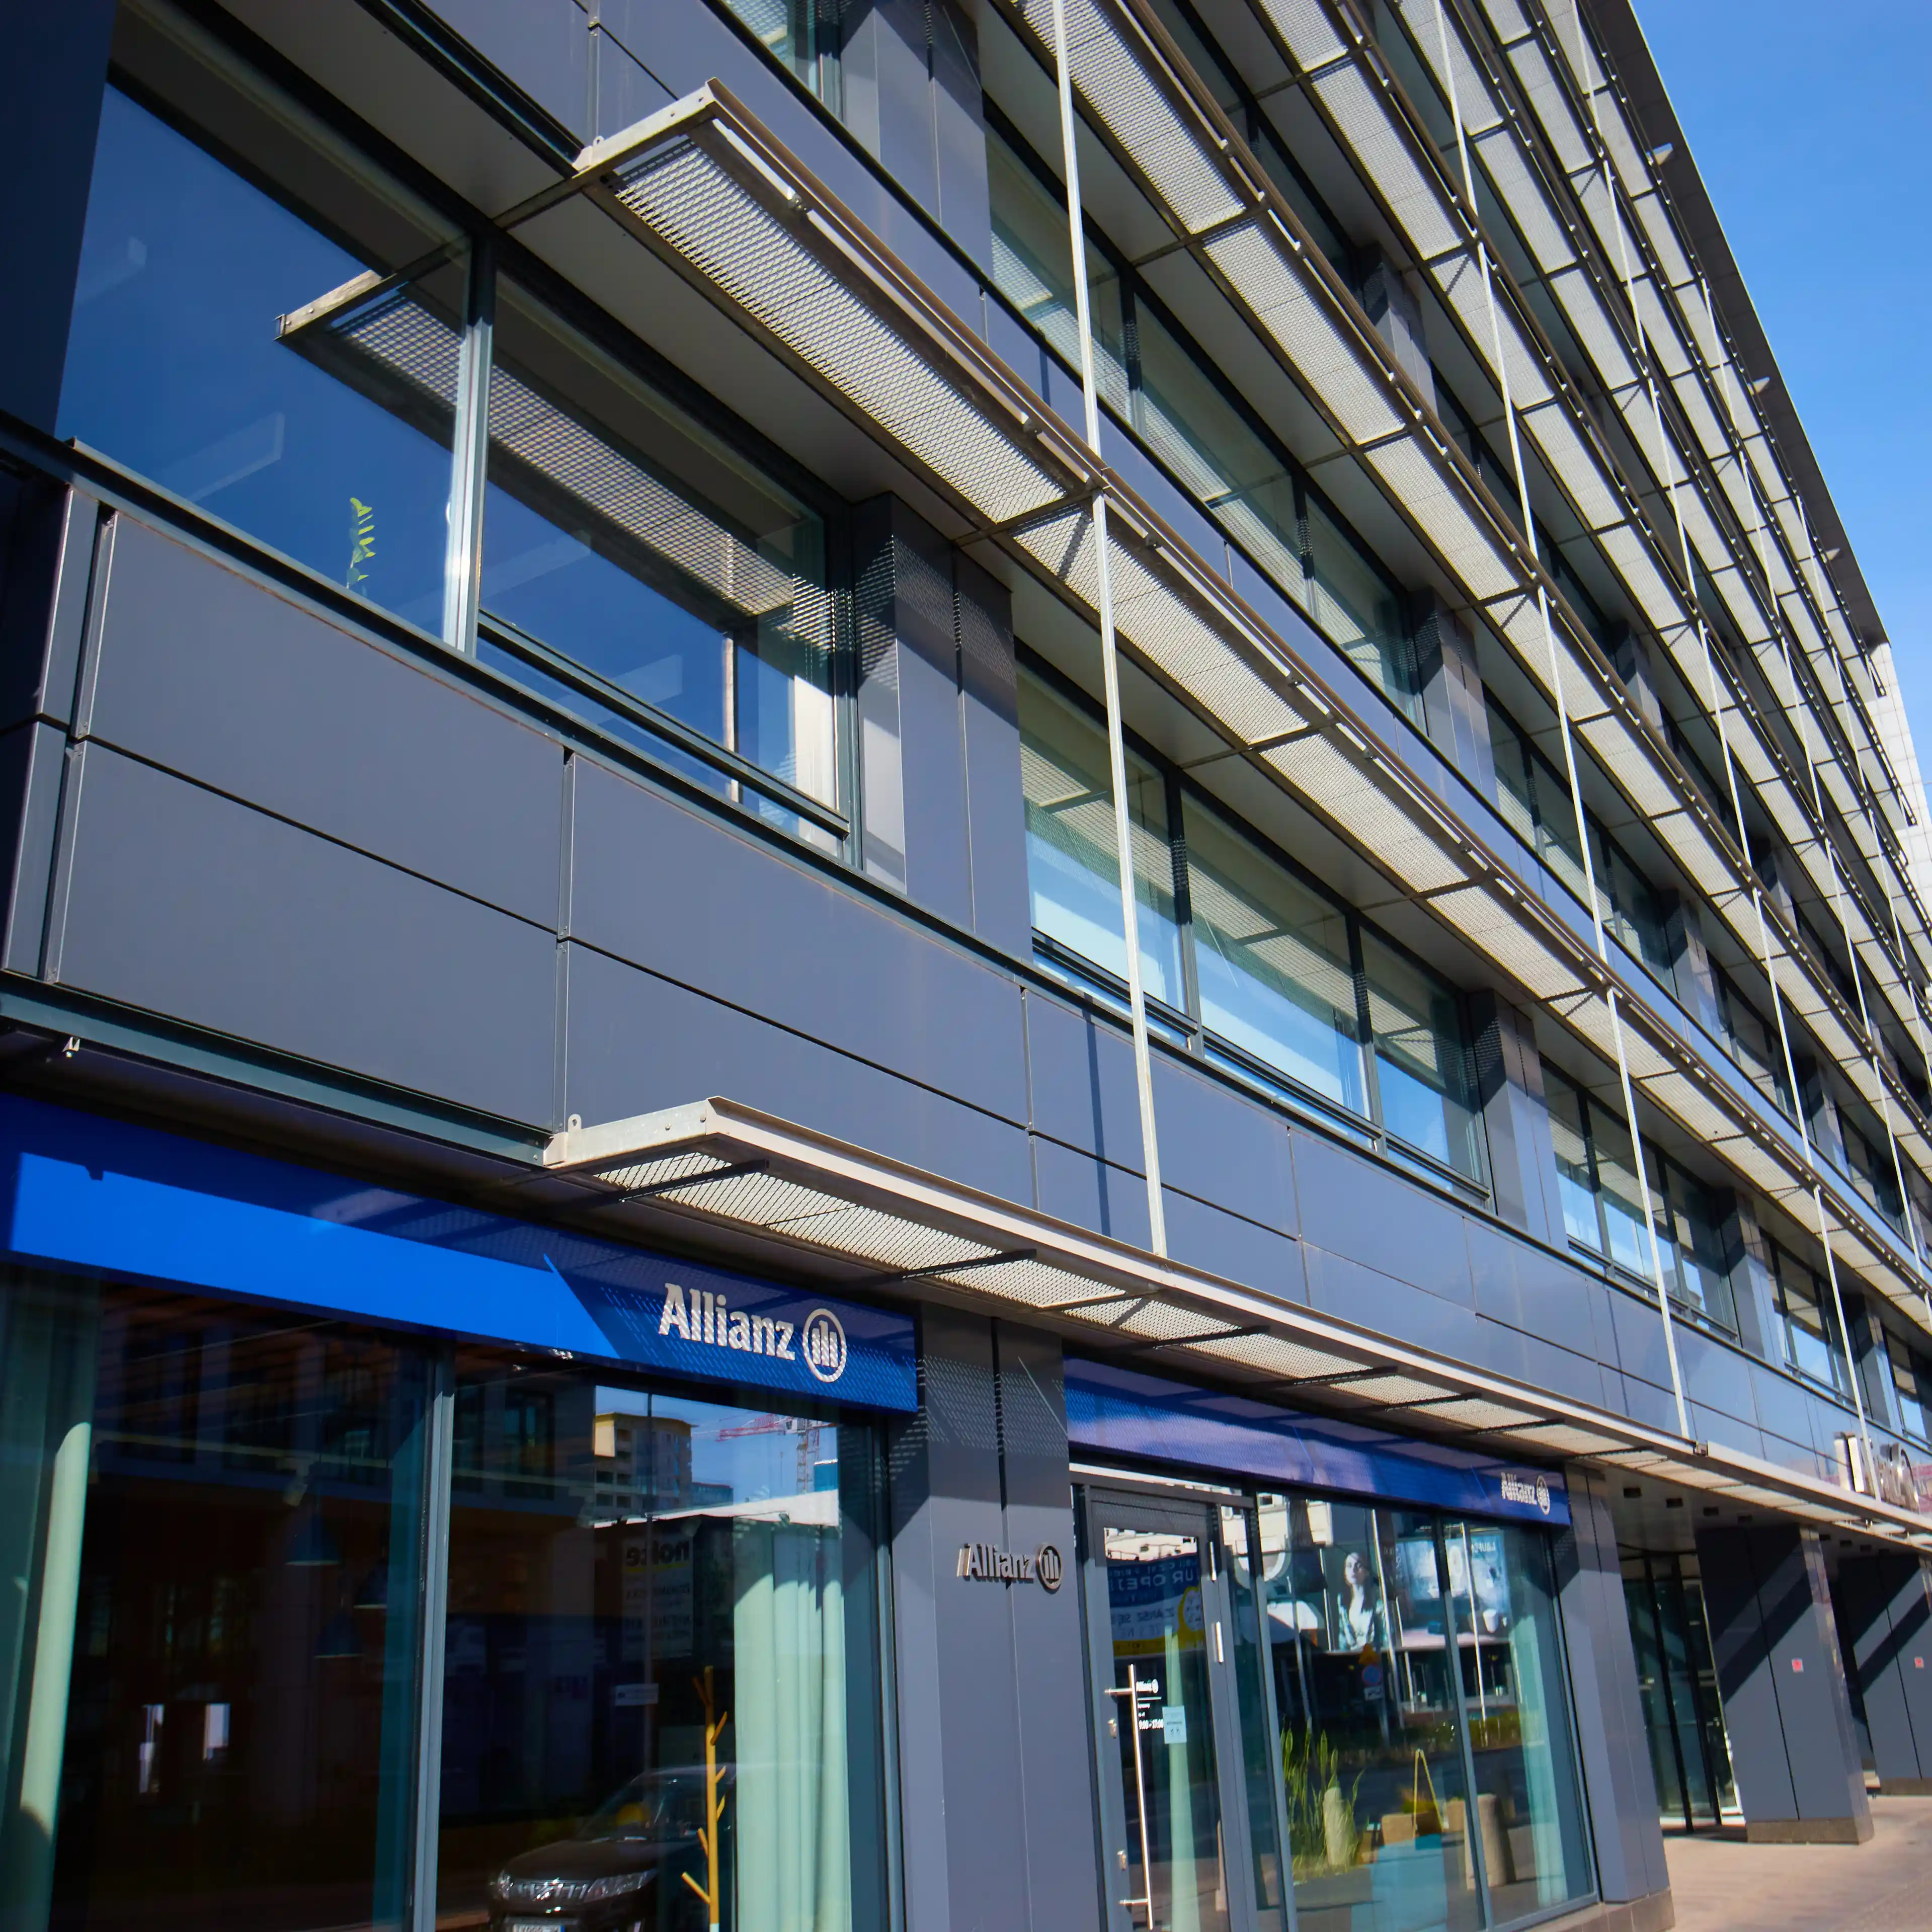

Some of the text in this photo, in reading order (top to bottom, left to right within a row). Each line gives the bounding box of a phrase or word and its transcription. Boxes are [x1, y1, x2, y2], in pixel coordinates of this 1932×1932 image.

[658, 1282, 796, 1361] Allianz
[1501, 1472, 1537, 1505] Allianz
[959, 1543, 1035, 1581] Allianz
